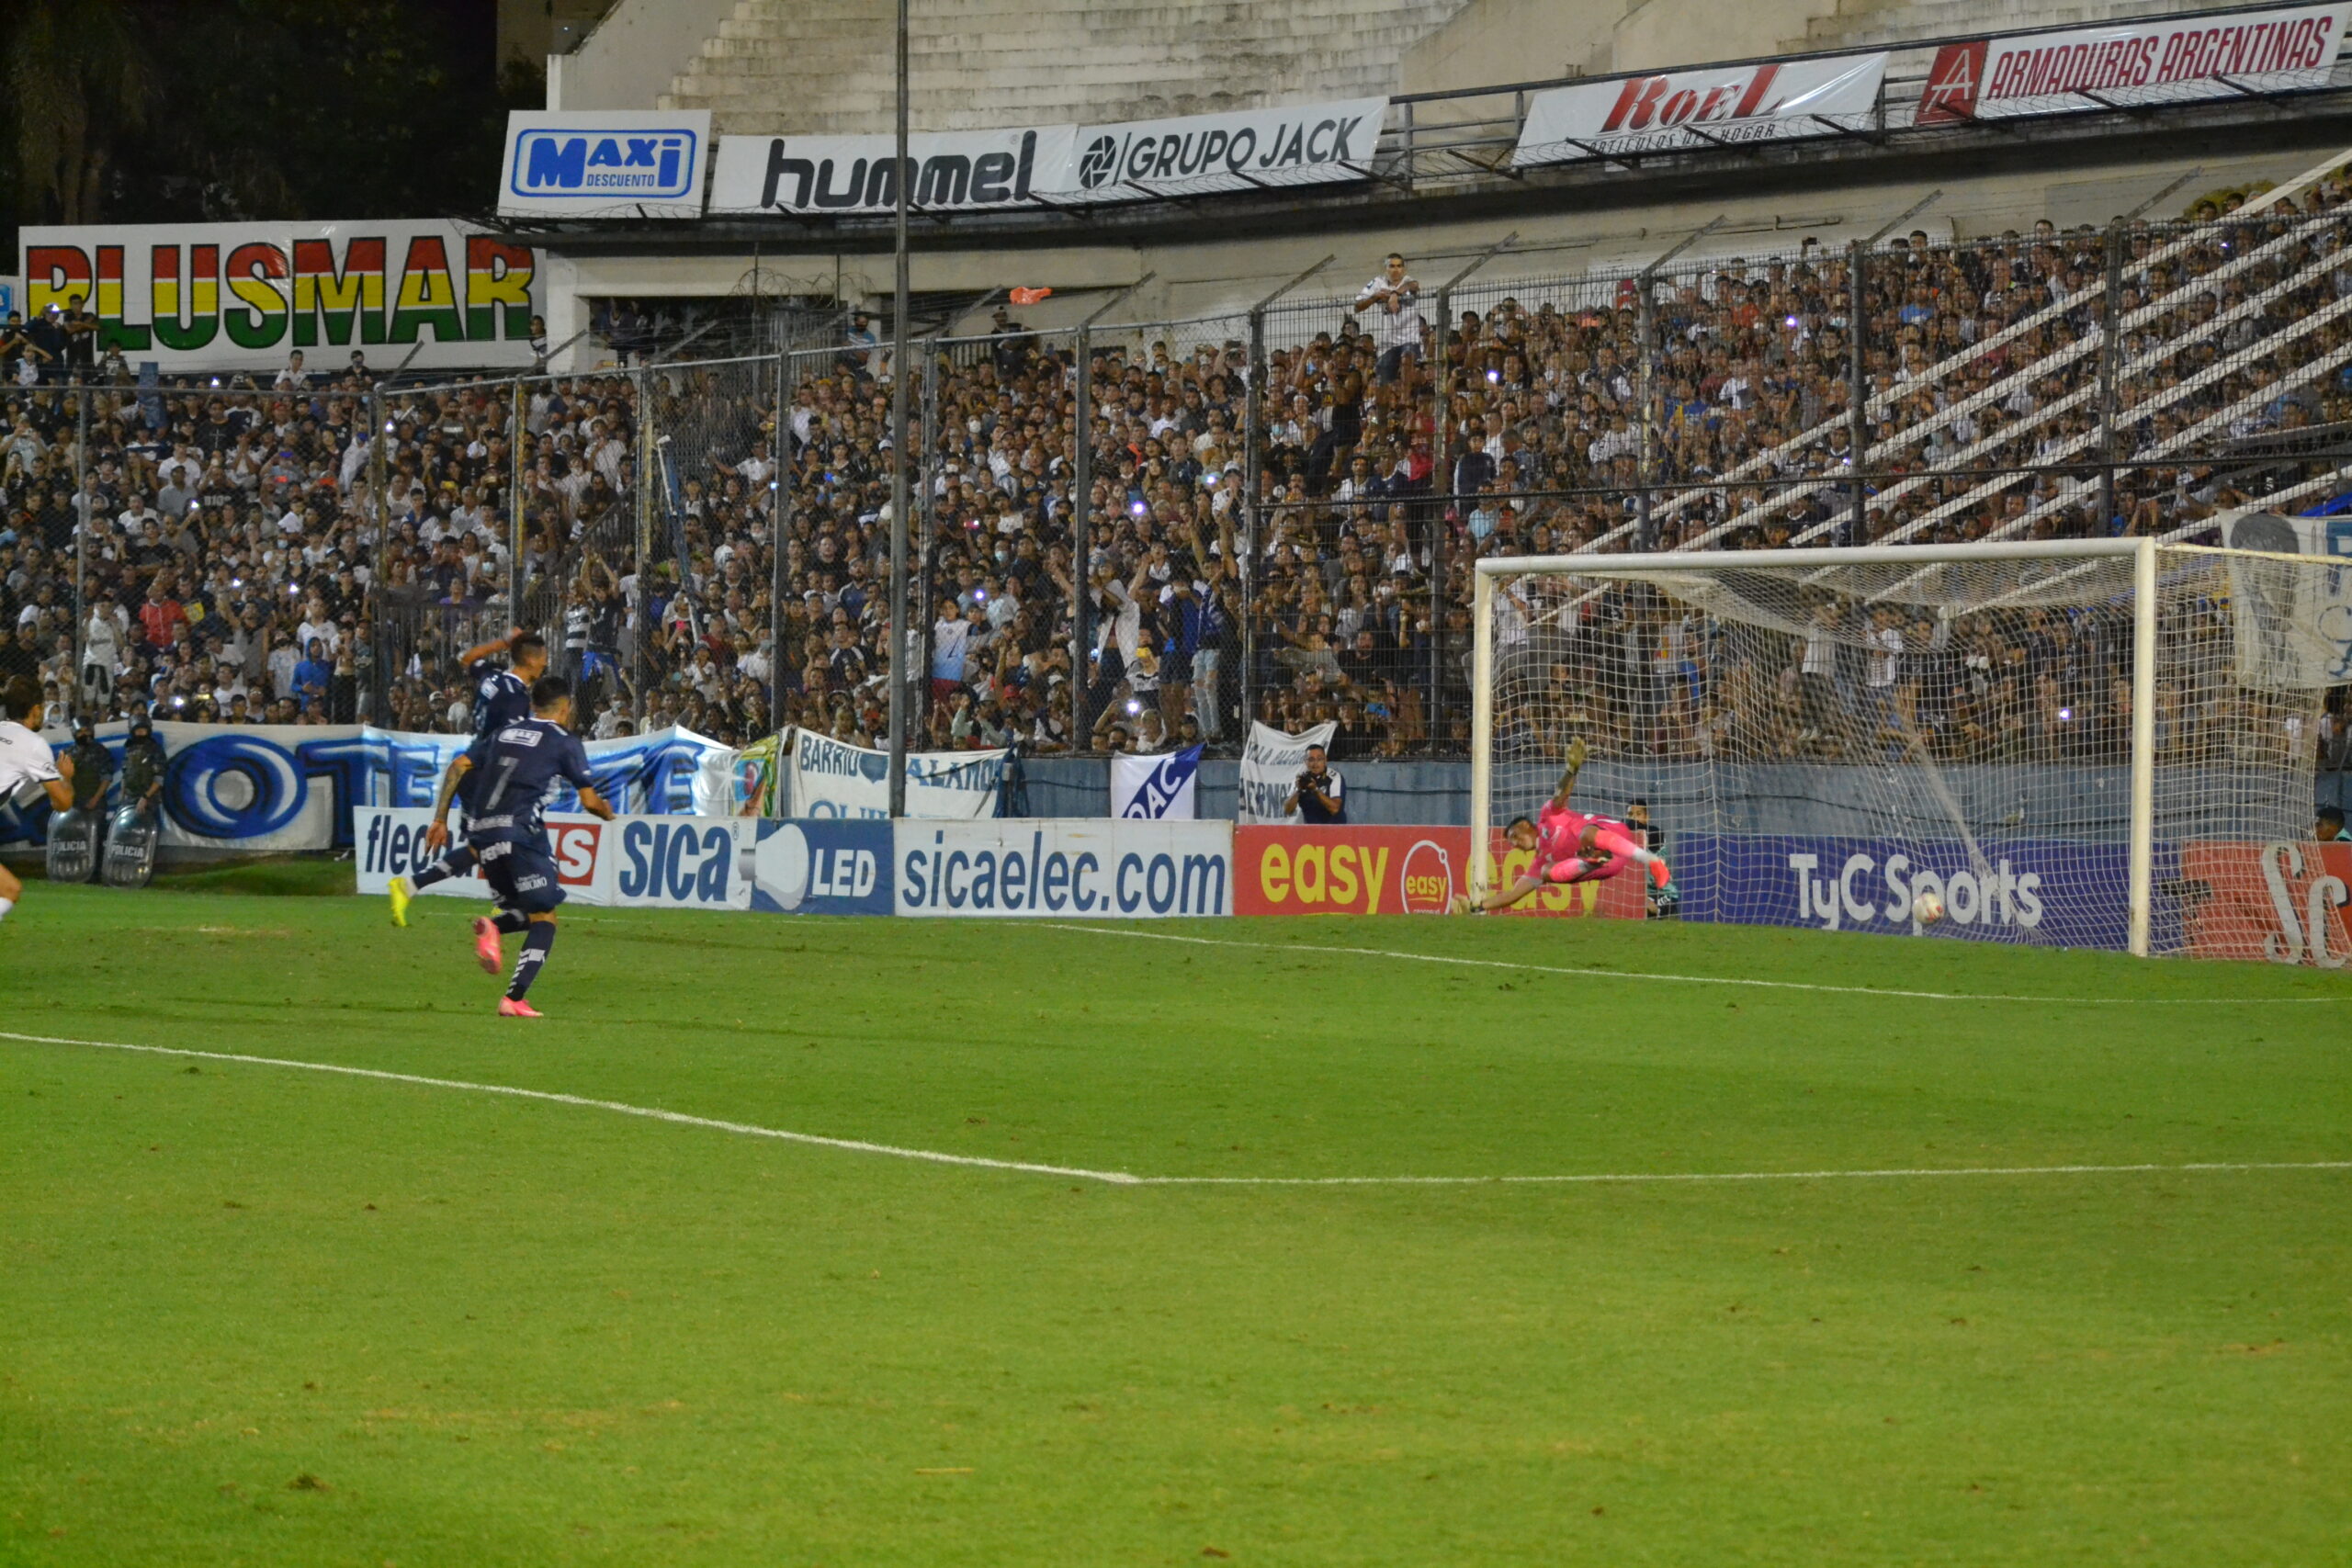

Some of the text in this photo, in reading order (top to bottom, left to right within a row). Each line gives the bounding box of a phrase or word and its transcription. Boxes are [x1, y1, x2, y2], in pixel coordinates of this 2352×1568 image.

[1986, 16, 2334, 100] ARMADURAS ARGENTINAS
[1127, 116, 1363, 179] GRUPO JACK
[1721, 123, 1776, 140] HOGAR
[586, 174, 655, 188] DESCUENTO
[761, 130, 1037, 209] hummel
[26, 235, 536, 351] PLUSMAR
[486, 758, 518, 810] 7
[619, 821, 732, 902] sica
[812, 849, 876, 897] LED
[902, 830, 1226, 917] sicaelec.com
[1260, 843, 1389, 913] easy
[1406, 875, 1447, 903] easy
[1789, 853, 2042, 936] TyC Sports
